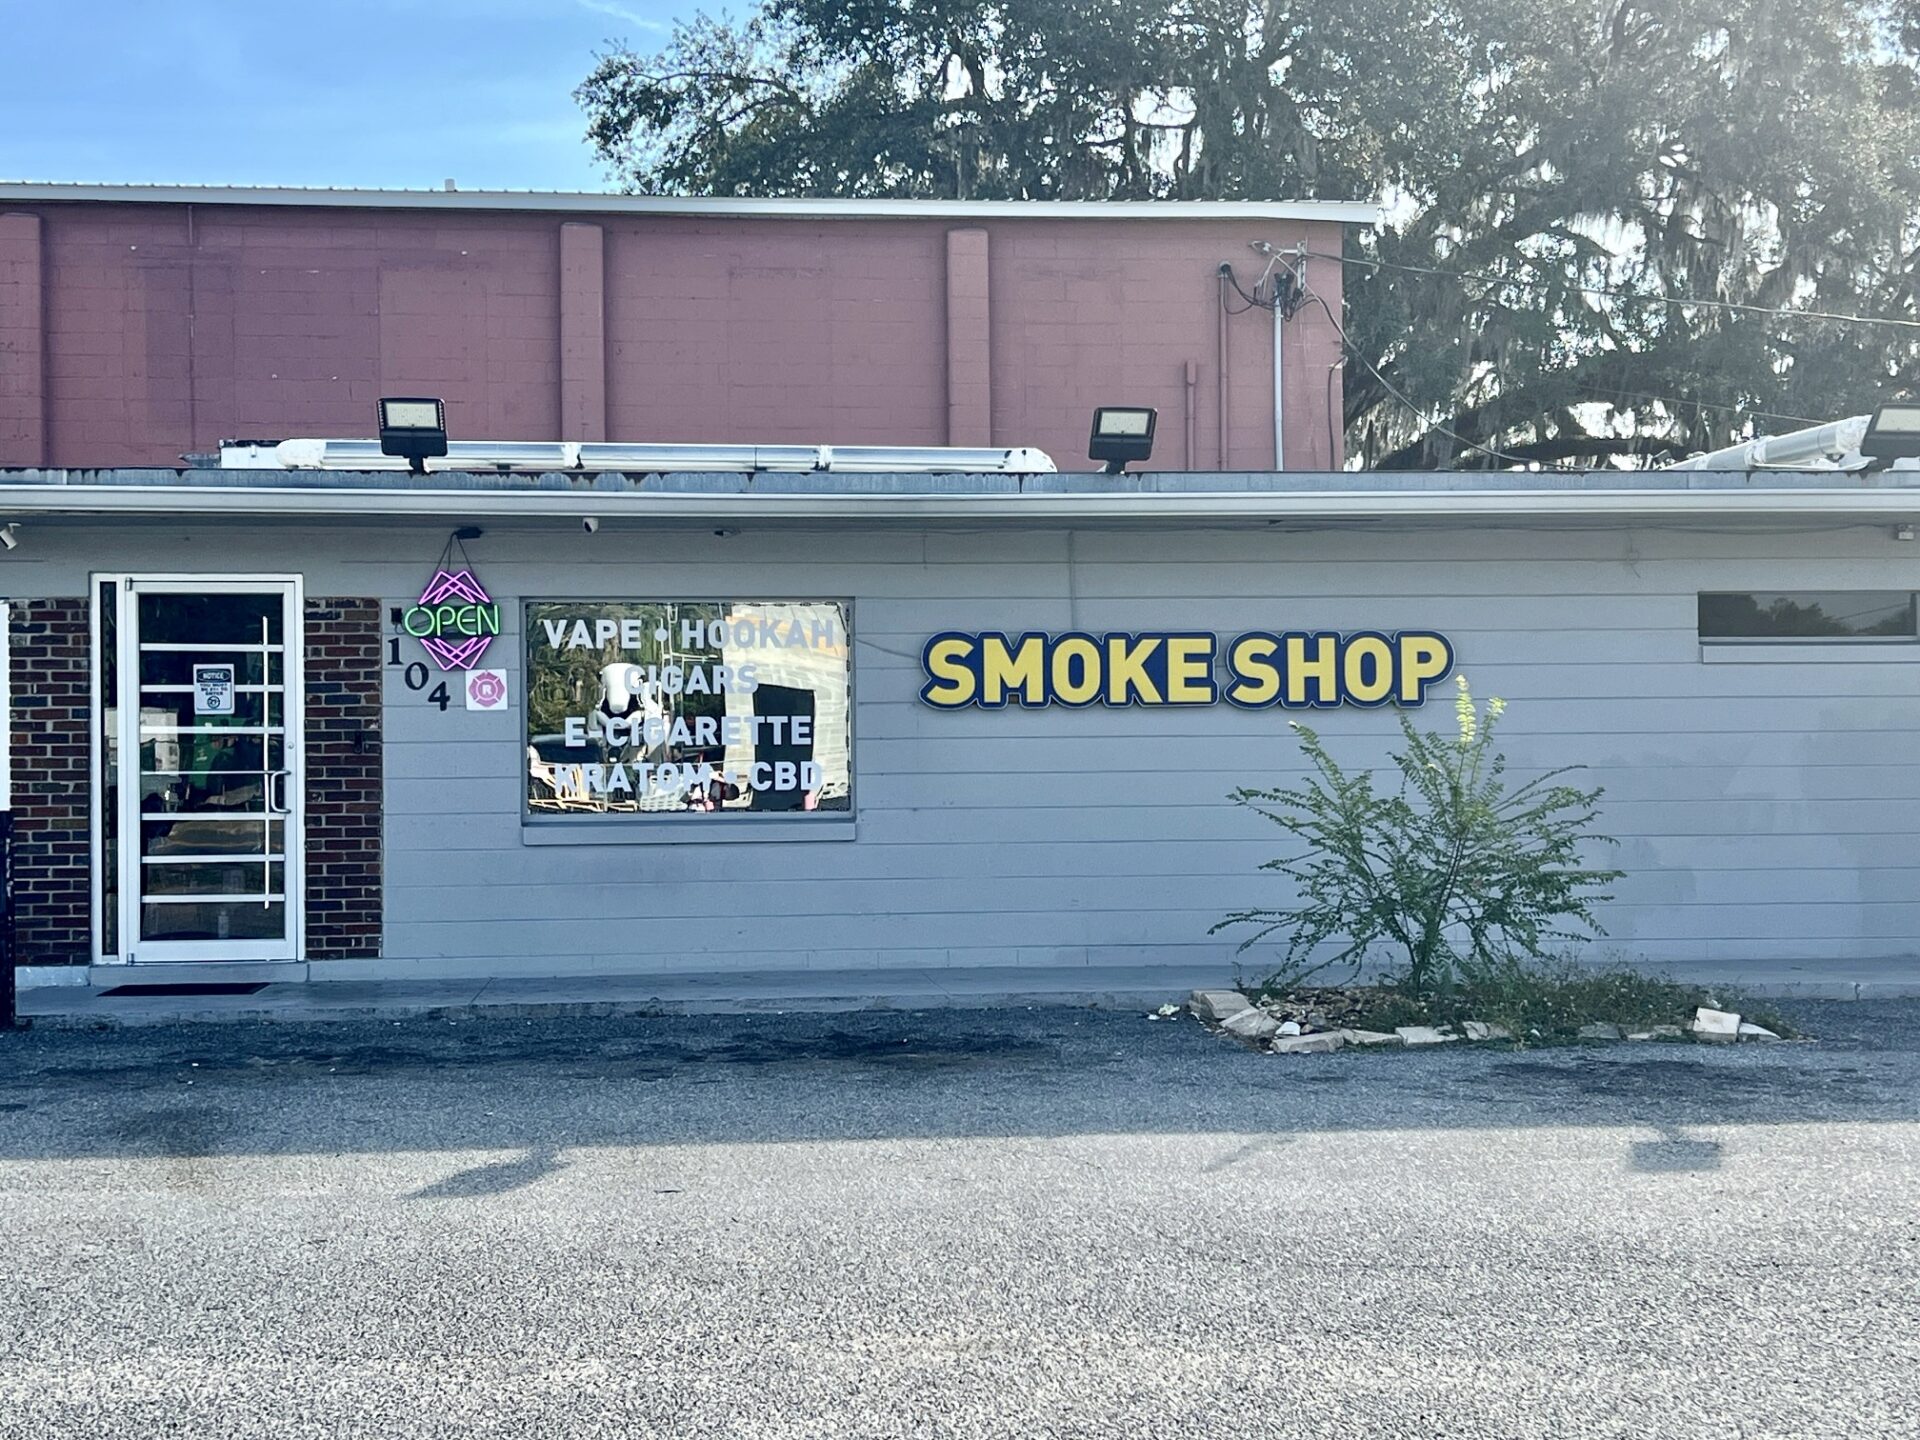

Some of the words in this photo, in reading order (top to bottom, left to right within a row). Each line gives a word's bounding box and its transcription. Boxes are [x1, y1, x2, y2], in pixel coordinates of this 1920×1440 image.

[404, 605, 499, 637] OPEN
[544, 619, 642, 649] VAPE
[682, 619, 834, 649] HOOKAH
[203, 672, 224, 680] NOTICE
[624, 663, 759, 695] CIGARS
[927, 638, 1214, 704] SMOKE
[1231, 637, 1449, 702] SHOP
[482, 685, 492, 695] R
[564, 715, 812, 748] E-CIGARETTE
[553, 762, 711, 793] KRATOM
[750, 761, 823, 791] CBD
